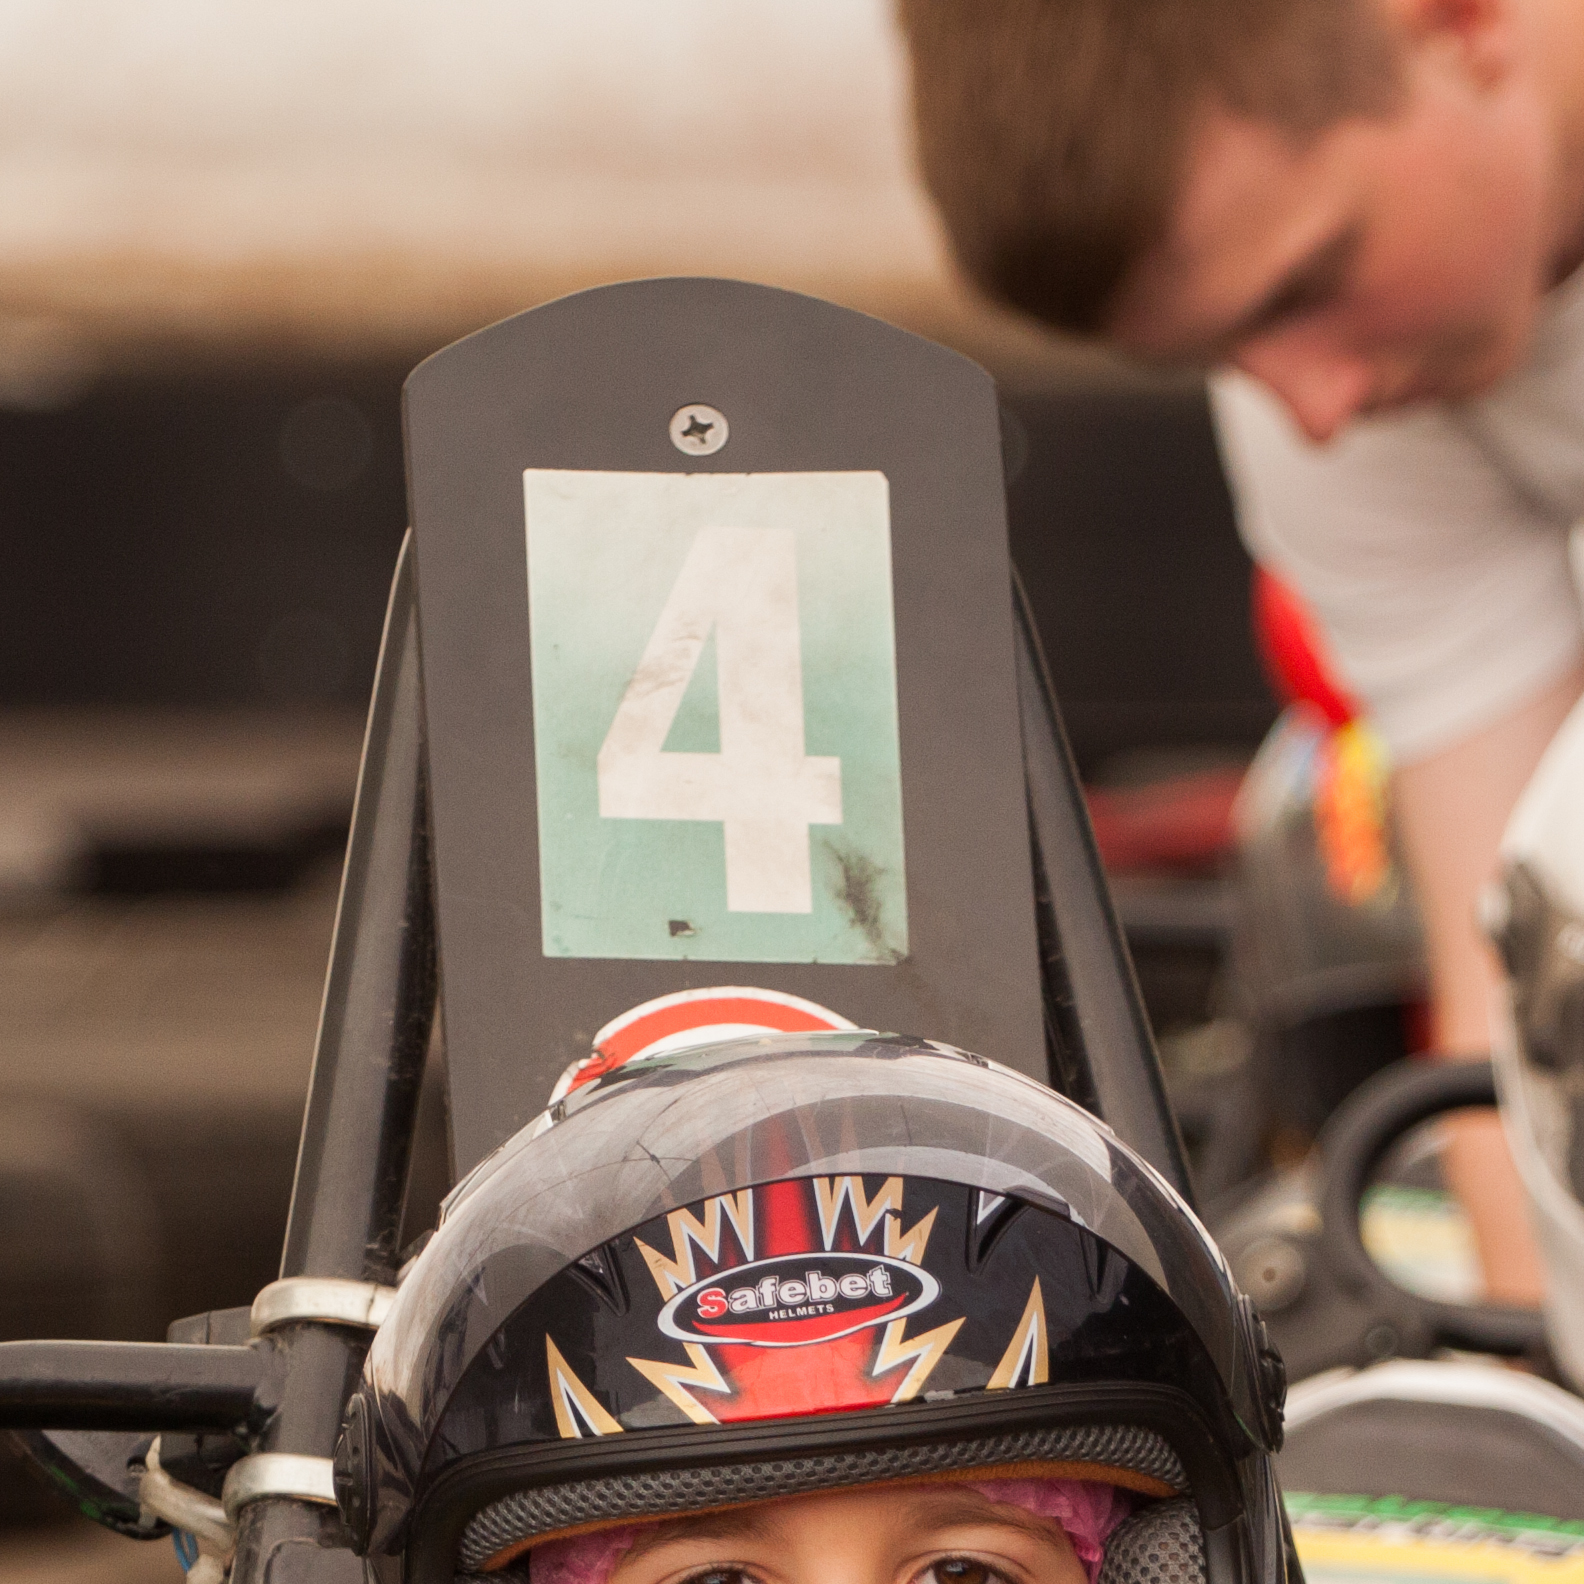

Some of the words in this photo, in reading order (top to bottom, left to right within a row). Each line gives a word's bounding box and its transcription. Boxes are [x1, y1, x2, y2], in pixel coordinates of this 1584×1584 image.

[597, 527, 842, 914] 4
[696, 1264, 894, 1320] Safebet
[768, 1303, 835, 1321] HELMETS
